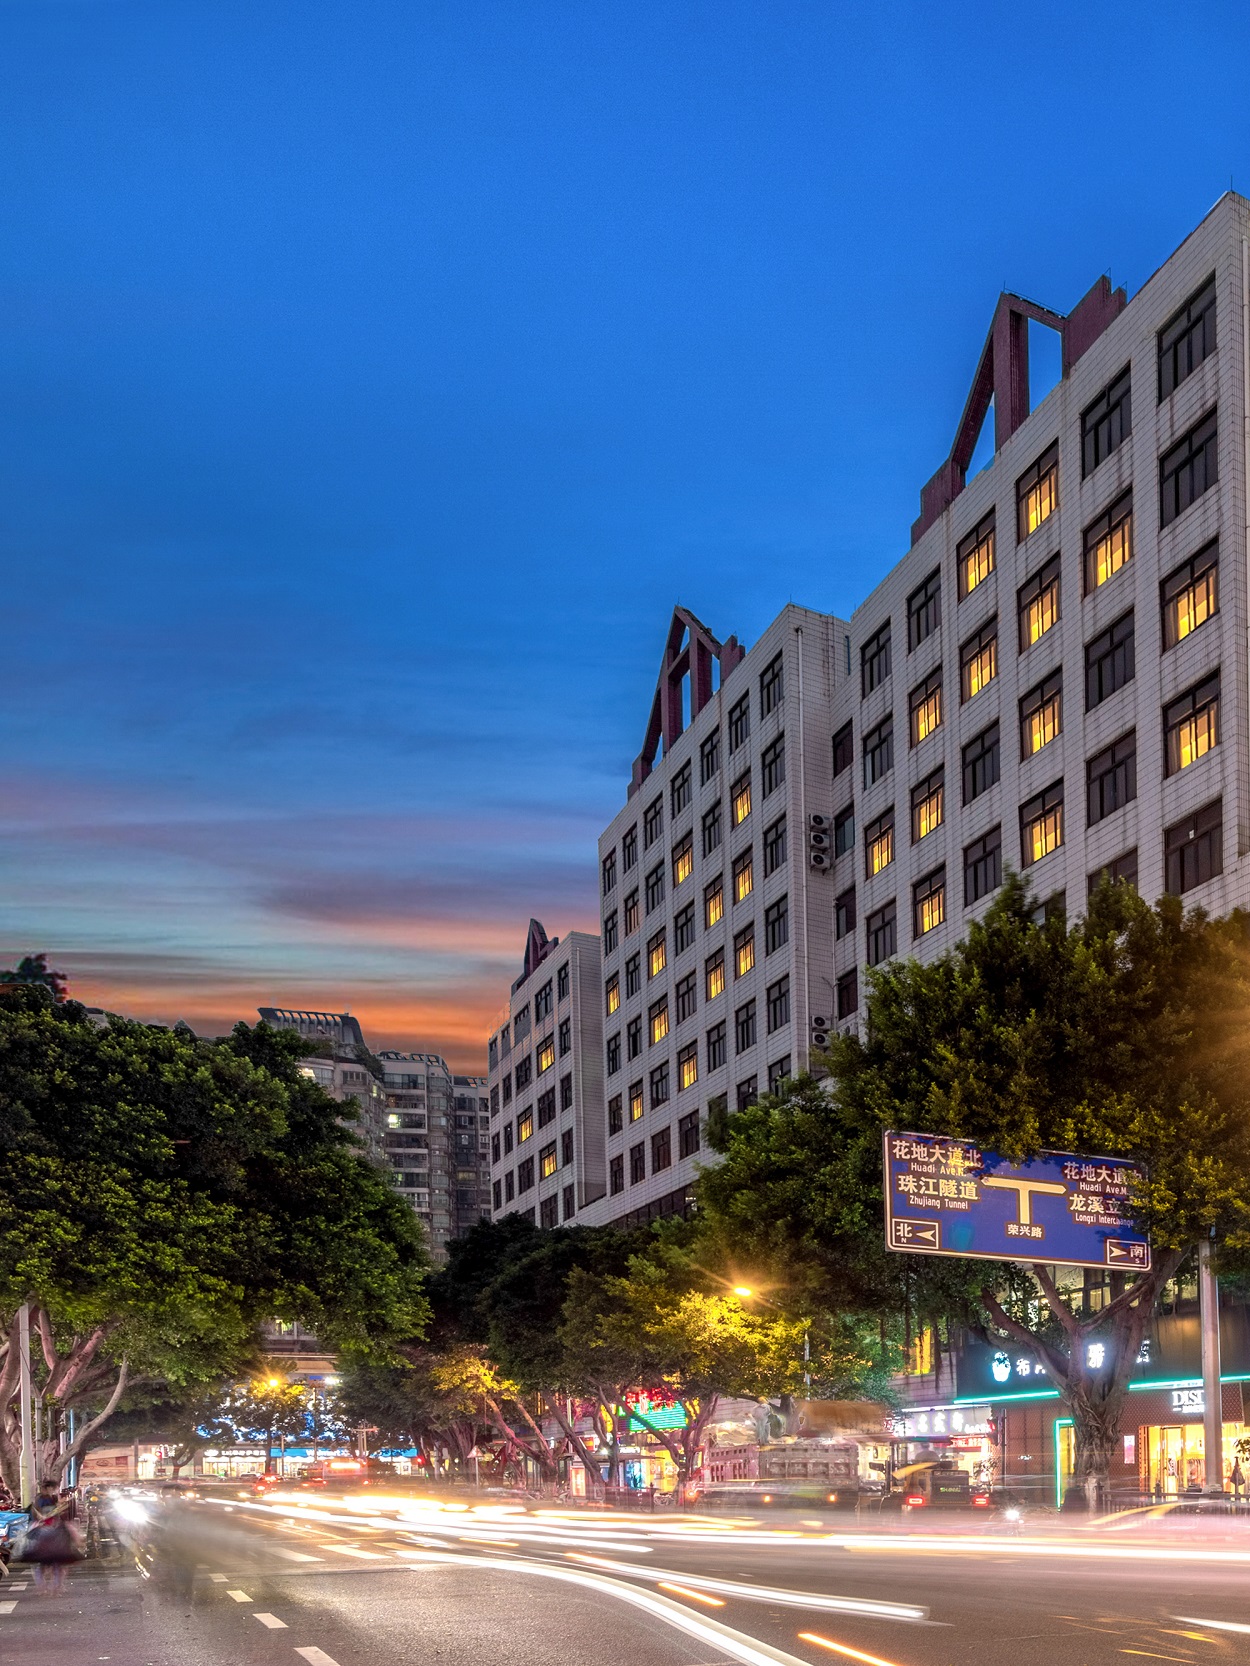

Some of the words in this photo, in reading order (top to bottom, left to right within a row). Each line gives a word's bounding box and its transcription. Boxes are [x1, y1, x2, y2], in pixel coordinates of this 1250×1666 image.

[892, 1139, 985, 1168] 花地大道北
[910, 1162, 936, 1173] Huadi
[897, 1174, 979, 1200] 珠江隧道
[1079, 1181, 1102, 1192] Huadi
[909, 1195, 941, 1209] Zhujiang
[944, 1198, 969, 1210] Tunnel
[1069, 1193, 1134, 1214] 龙溪立
[1075, 1212, 1097, 1225] Longxi
[1098, 1214, 1134, 1228] Interchange
[896, 1222, 913, 1238] 北
[1007, 1223, 1043, 1238] 荣兴路
[1129, 1245, 1144, 1258] 南
